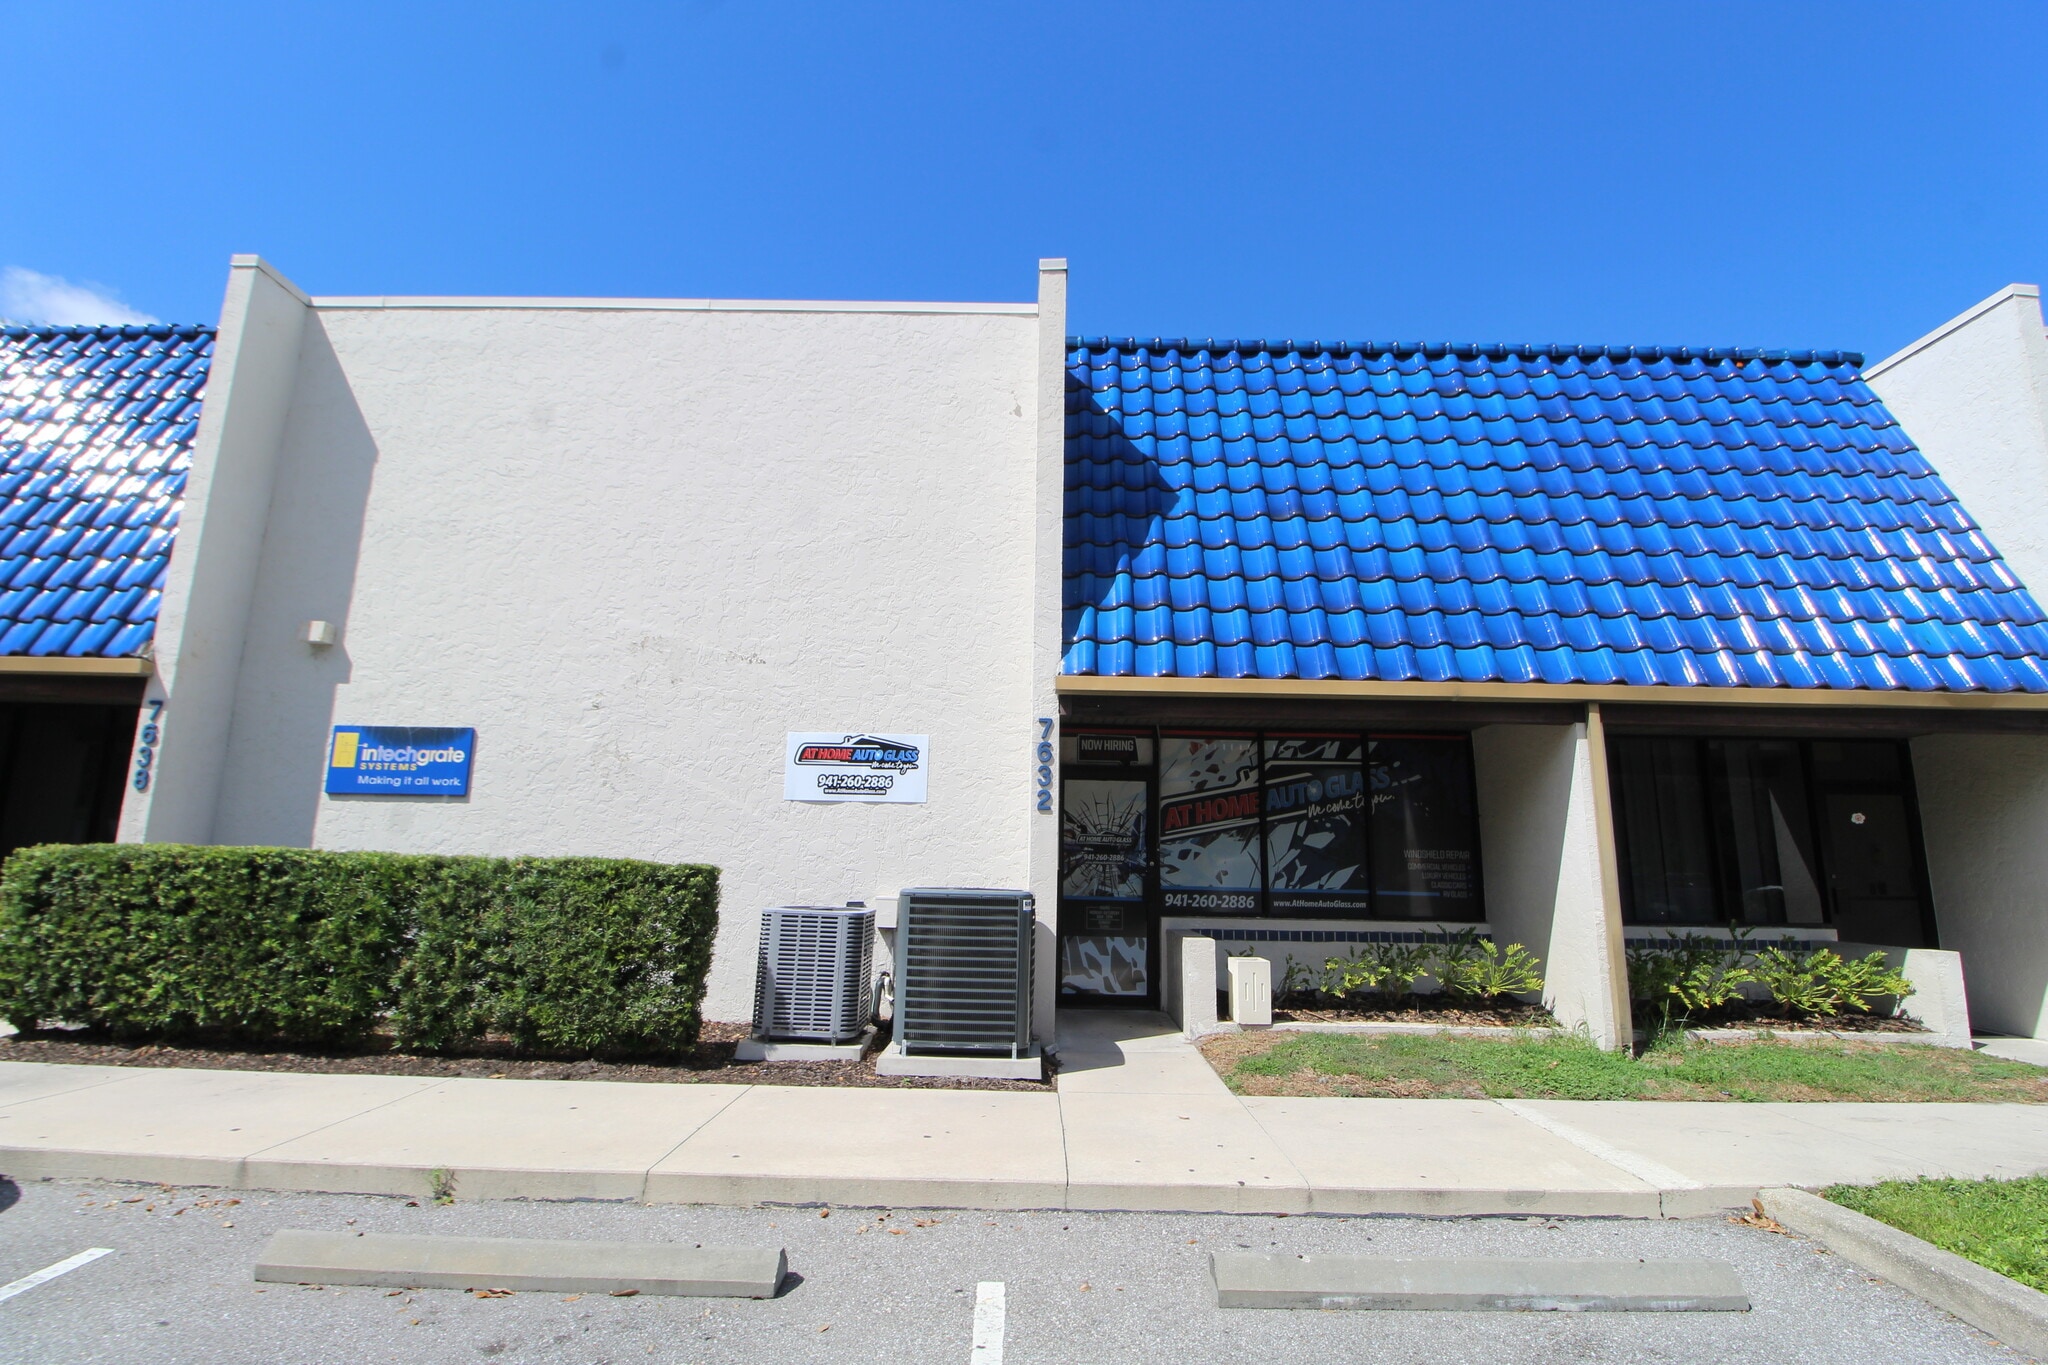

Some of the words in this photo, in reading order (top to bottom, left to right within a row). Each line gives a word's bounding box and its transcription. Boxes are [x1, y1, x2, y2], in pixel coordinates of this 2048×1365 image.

[134, 700, 163, 790] 7638
[1081, 739, 1103, 751] NOW
[1104, 739, 1134, 752] HIRING
[361, 744, 465, 766] intechgrate
[802, 748, 818, 760] AT
[820, 748, 852, 760] HOME
[853, 749, 883, 761] AUTO
[884, 749, 919, 762] GLASS
[360, 762, 417, 771] SYSTEMS
[1037, 718, 1053, 810] 7632
[357, 775, 401, 787] Making
[404, 776, 413, 785] it
[415, 776, 429, 786] all
[818, 775, 892, 788] 941-260-2886
[1164, 804, 1192, 830] AT
[1195, 792, 1259, 824] HOME
[1266, 780, 1323, 811] AUTO
[1324, 766, 1391, 798] GLASS
[1307, 803, 1325, 818] We
[1326, 800, 1353, 814] come
[1404, 849, 1445, 859] WINDSHIELD
[1446, 850, 1470, 860] REPAIR
[1407, 863, 1440, 871] COMMERCIAL
[1165, 893, 1255, 909] 941-260-2886
[1273, 899, 1367, 909] www.AtHomeAutoGlass.com
